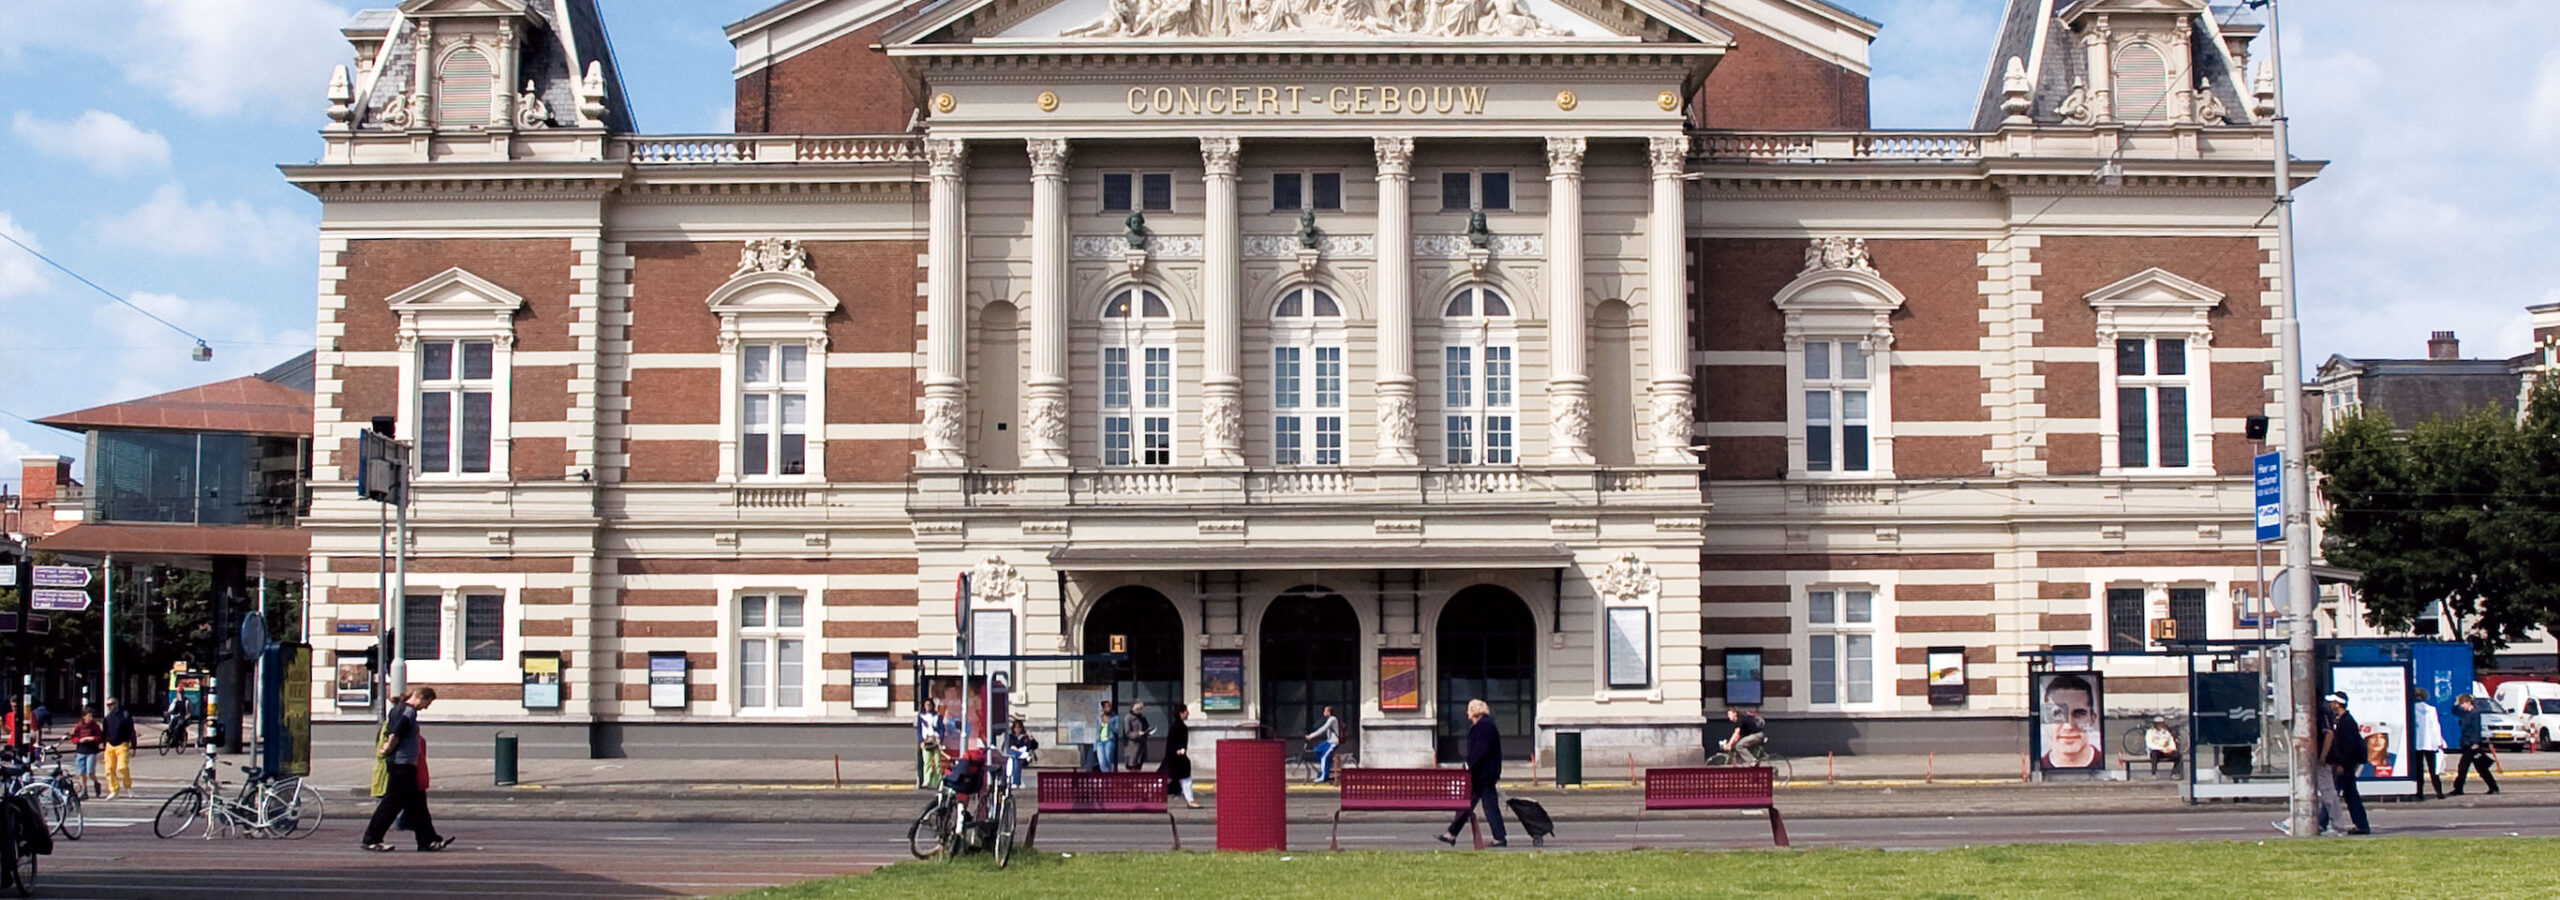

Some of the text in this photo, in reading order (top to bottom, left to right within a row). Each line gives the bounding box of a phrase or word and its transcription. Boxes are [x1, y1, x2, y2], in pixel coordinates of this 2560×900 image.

[1126, 85, 1489, 114] CONCERT-GEBOUW
[2162, 621, 2175, 637] H
[1111, 637, 1123, 650] H
